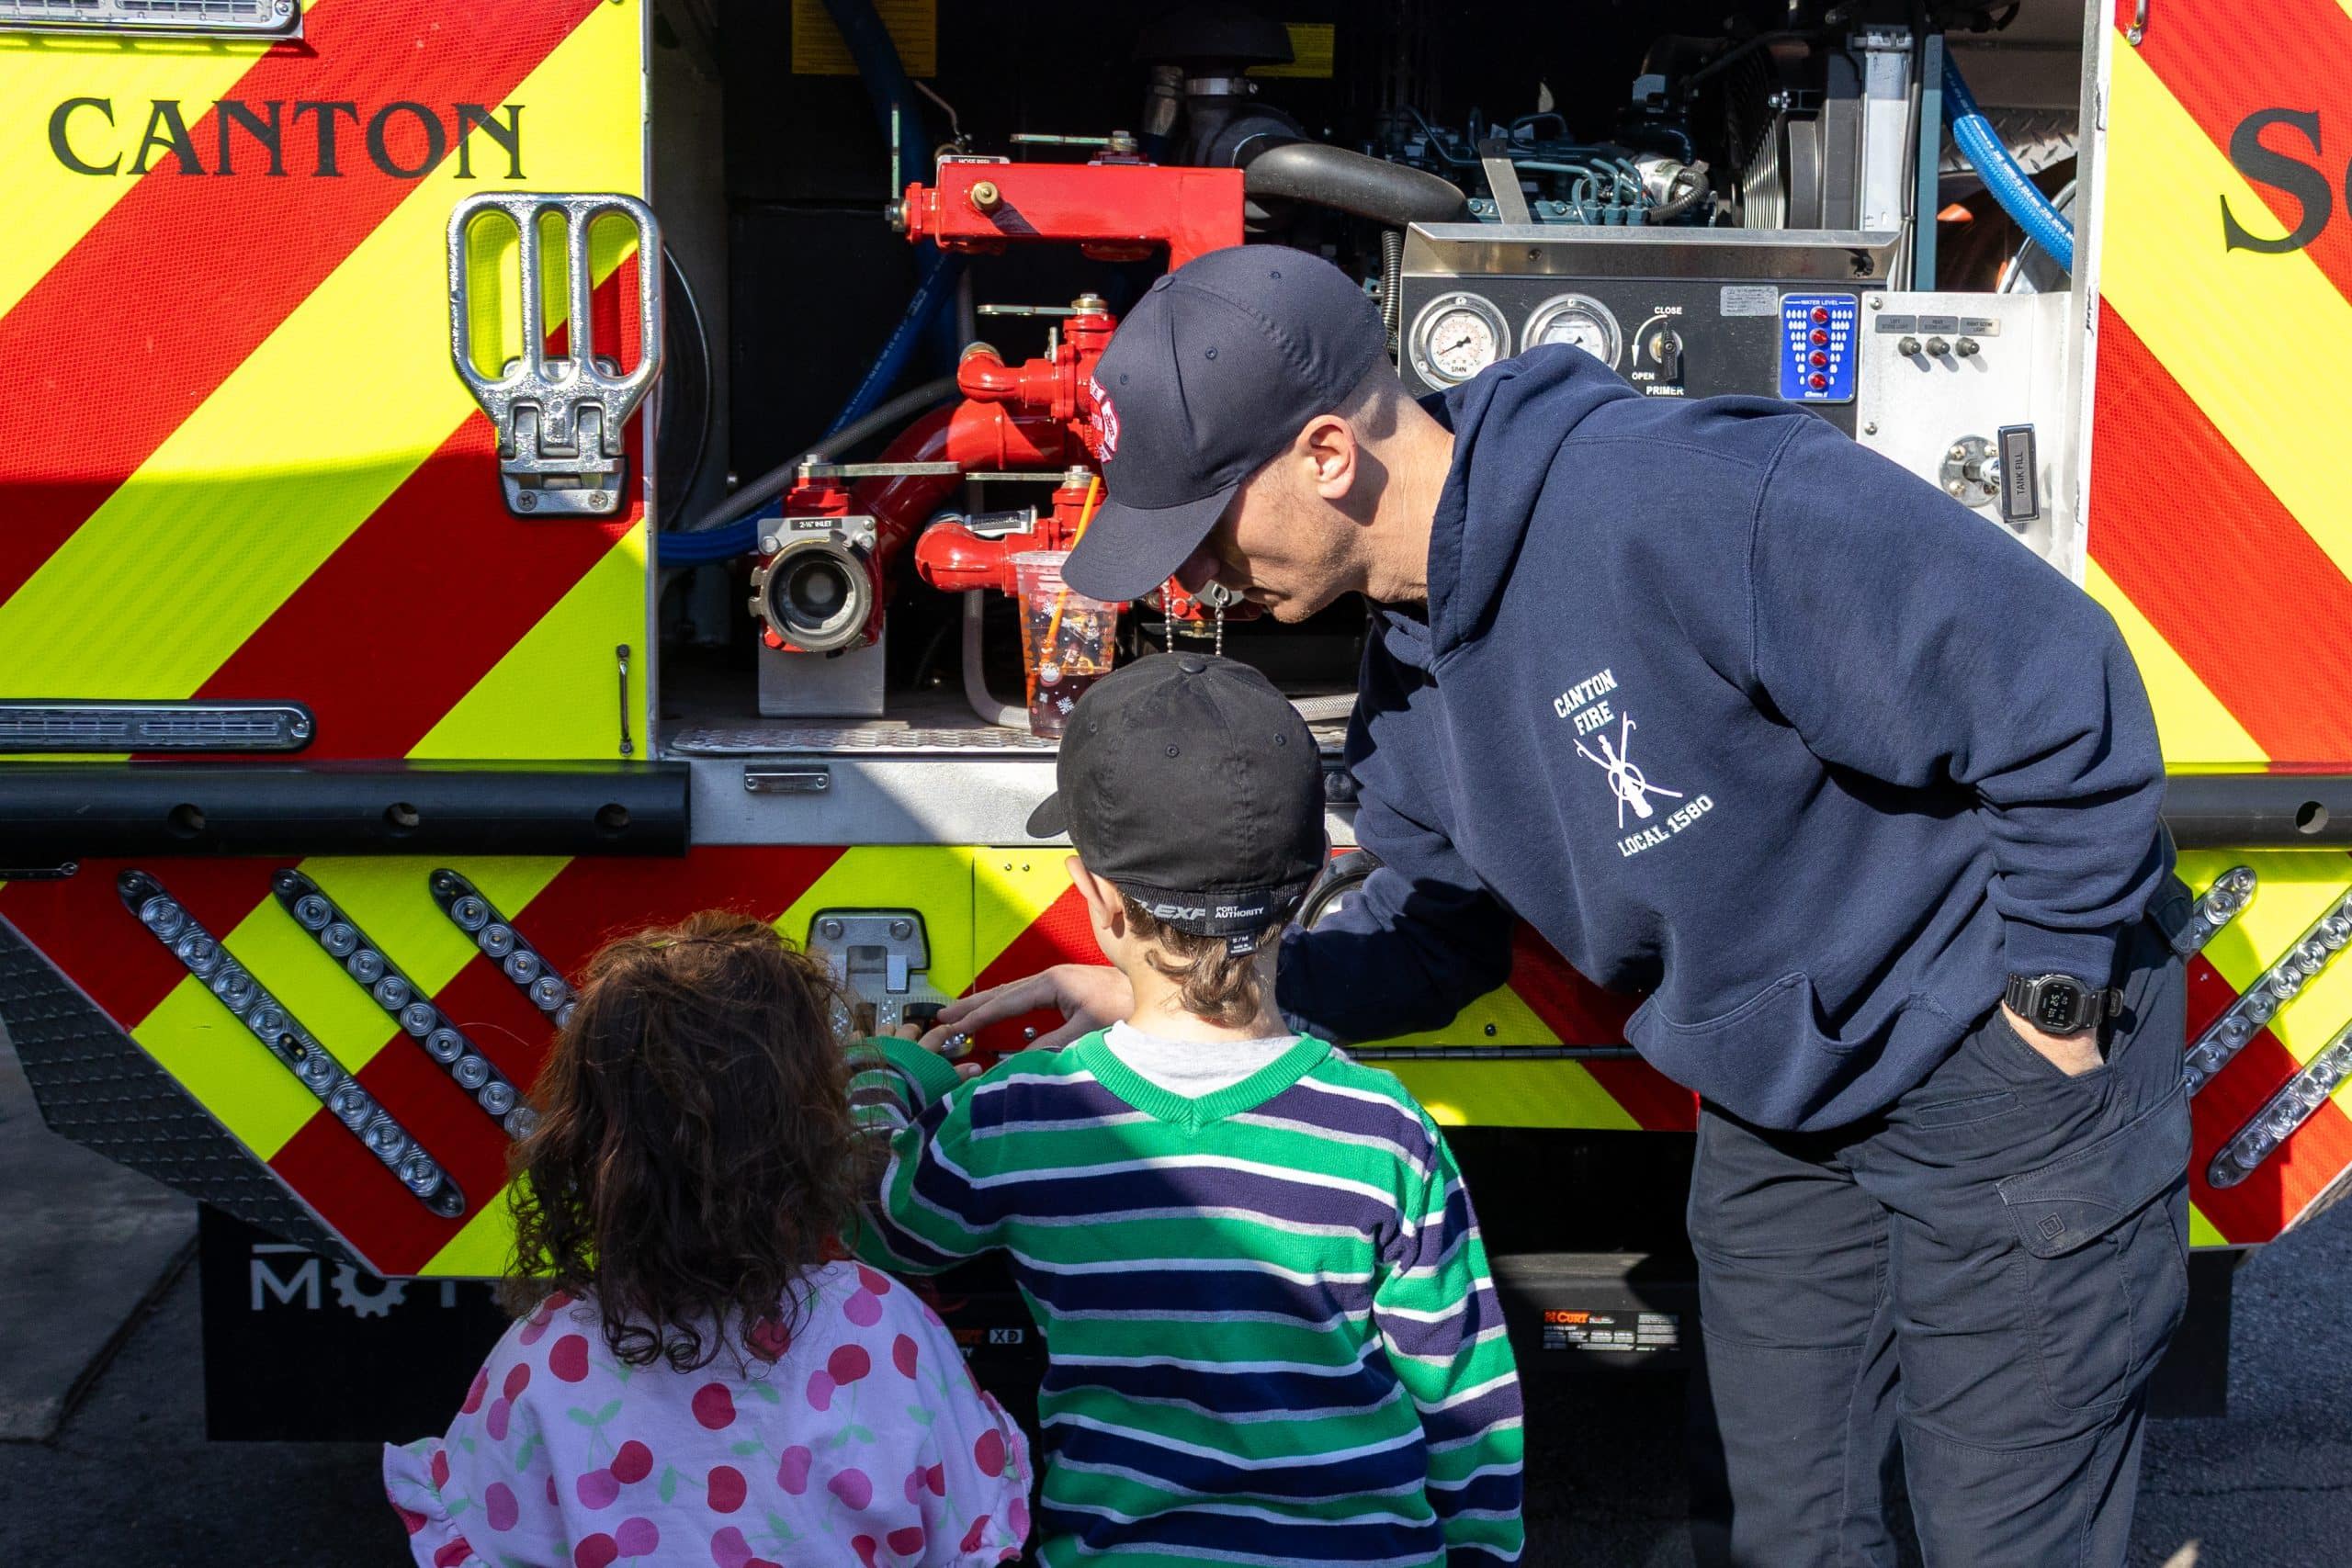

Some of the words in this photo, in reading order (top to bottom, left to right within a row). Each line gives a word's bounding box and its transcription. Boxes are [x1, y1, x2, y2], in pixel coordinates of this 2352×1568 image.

[48, 96, 527, 180] CANTON
[2220, 107, 2352, 254] S
[1654, 306, 1683, 315] CLOSE
[1632, 371, 1655, 380] OPEN
[1645, 386, 1684, 396] PRIMER
[2014, 451, 2024, 470] FILL
[2016, 471, 2026, 496] TANK
[814, 520, 831, 528] INLET
[1553, 668, 1618, 718] CANTON
[1572, 700, 1615, 737] FIRE
[1616, 824, 1671, 858] LOCAL
[1665, 794, 1714, 834] 1580
[1215, 907, 1264, 919] AUTHORITY
[1216, 905, 1238, 913] PORT
[1557, 1311, 1590, 1324] CURT
[992, 1329, 1020, 1343] XD
